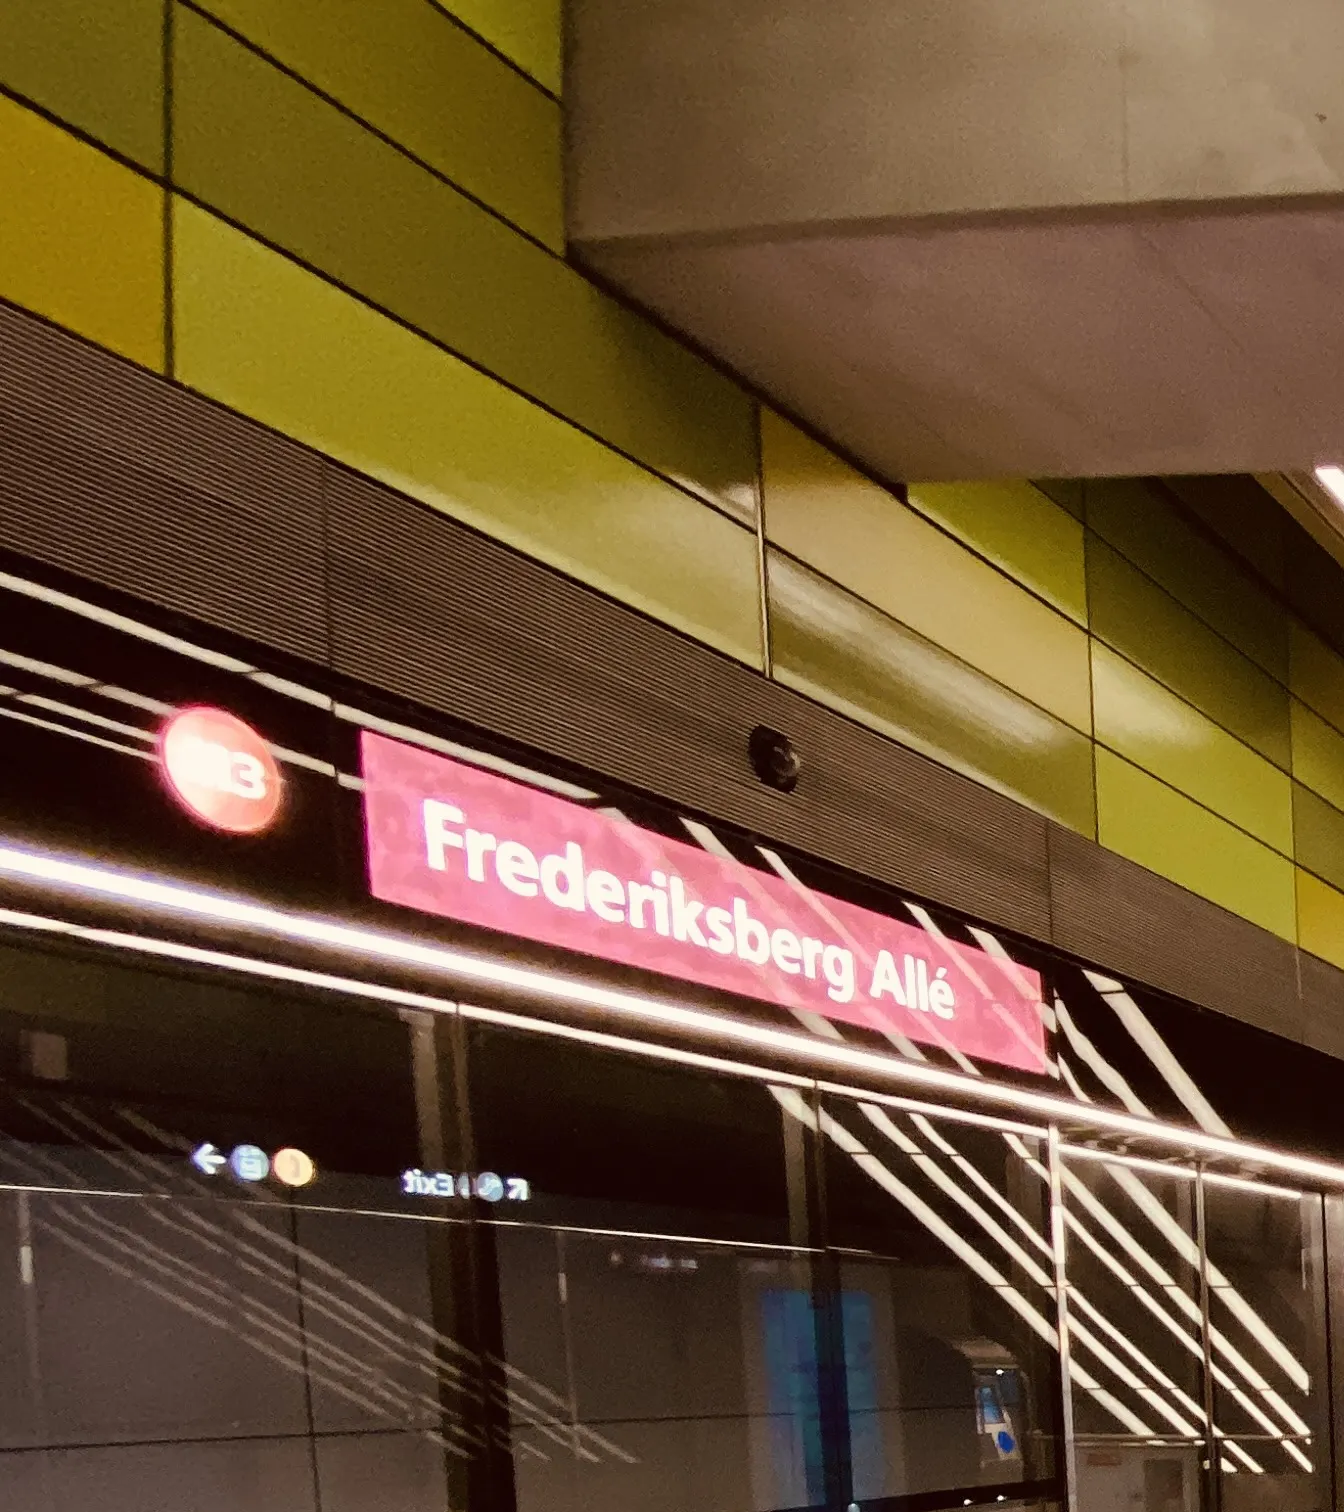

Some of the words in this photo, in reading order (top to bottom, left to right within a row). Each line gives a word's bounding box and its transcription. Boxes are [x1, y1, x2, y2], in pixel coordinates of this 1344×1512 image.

[178, 736, 267, 799] 3
[421, 799, 855, 1004] Frederiksberg
[870, 949, 956, 1019] Allé
